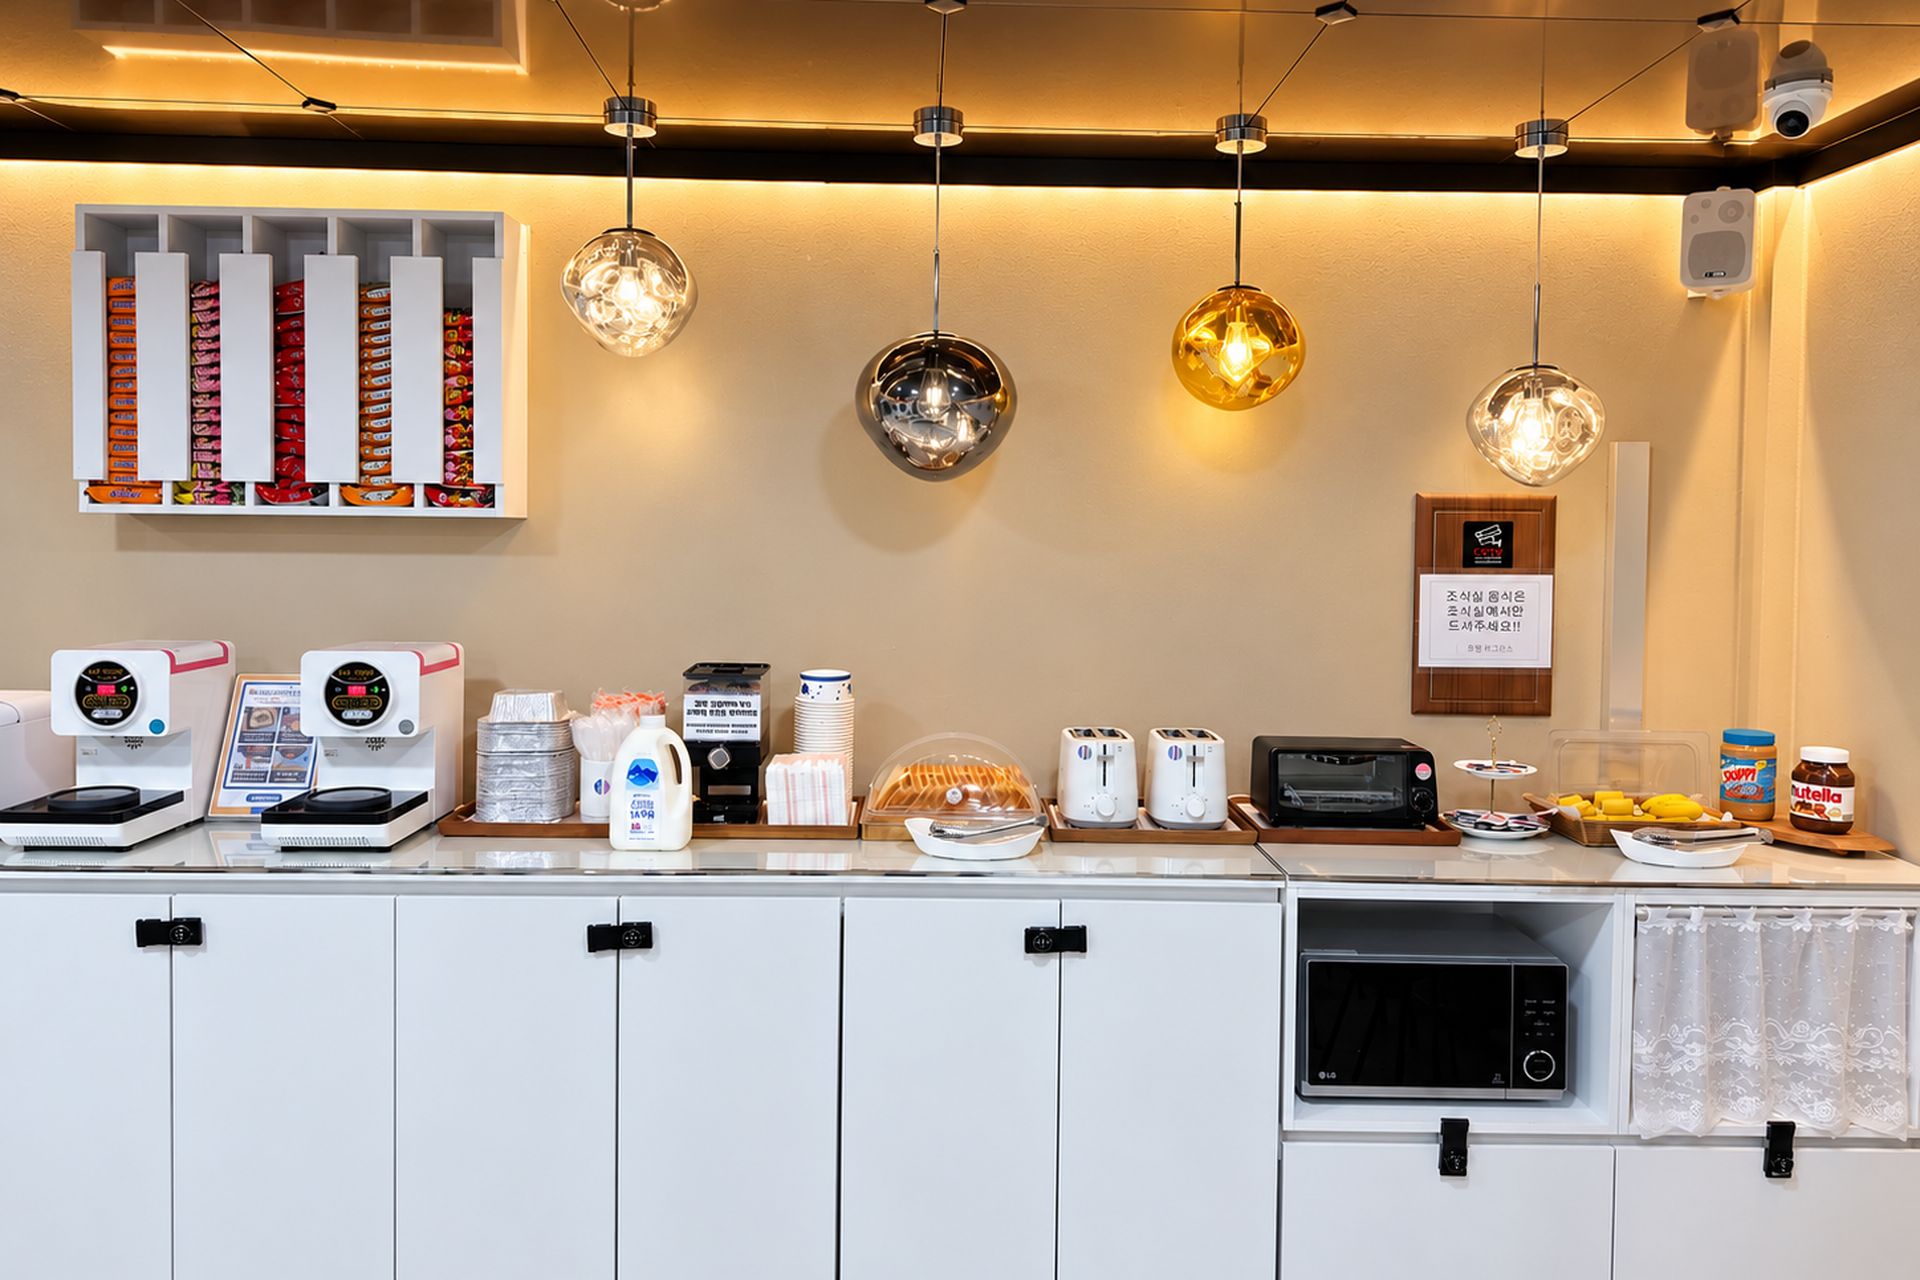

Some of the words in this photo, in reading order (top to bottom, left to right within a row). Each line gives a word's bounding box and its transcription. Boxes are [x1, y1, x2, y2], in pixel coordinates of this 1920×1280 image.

[1446, 590, 1483, 603] 조식실
[1488, 590, 1525, 603] 음식은
[1791, 784, 1843, 804] nutella
